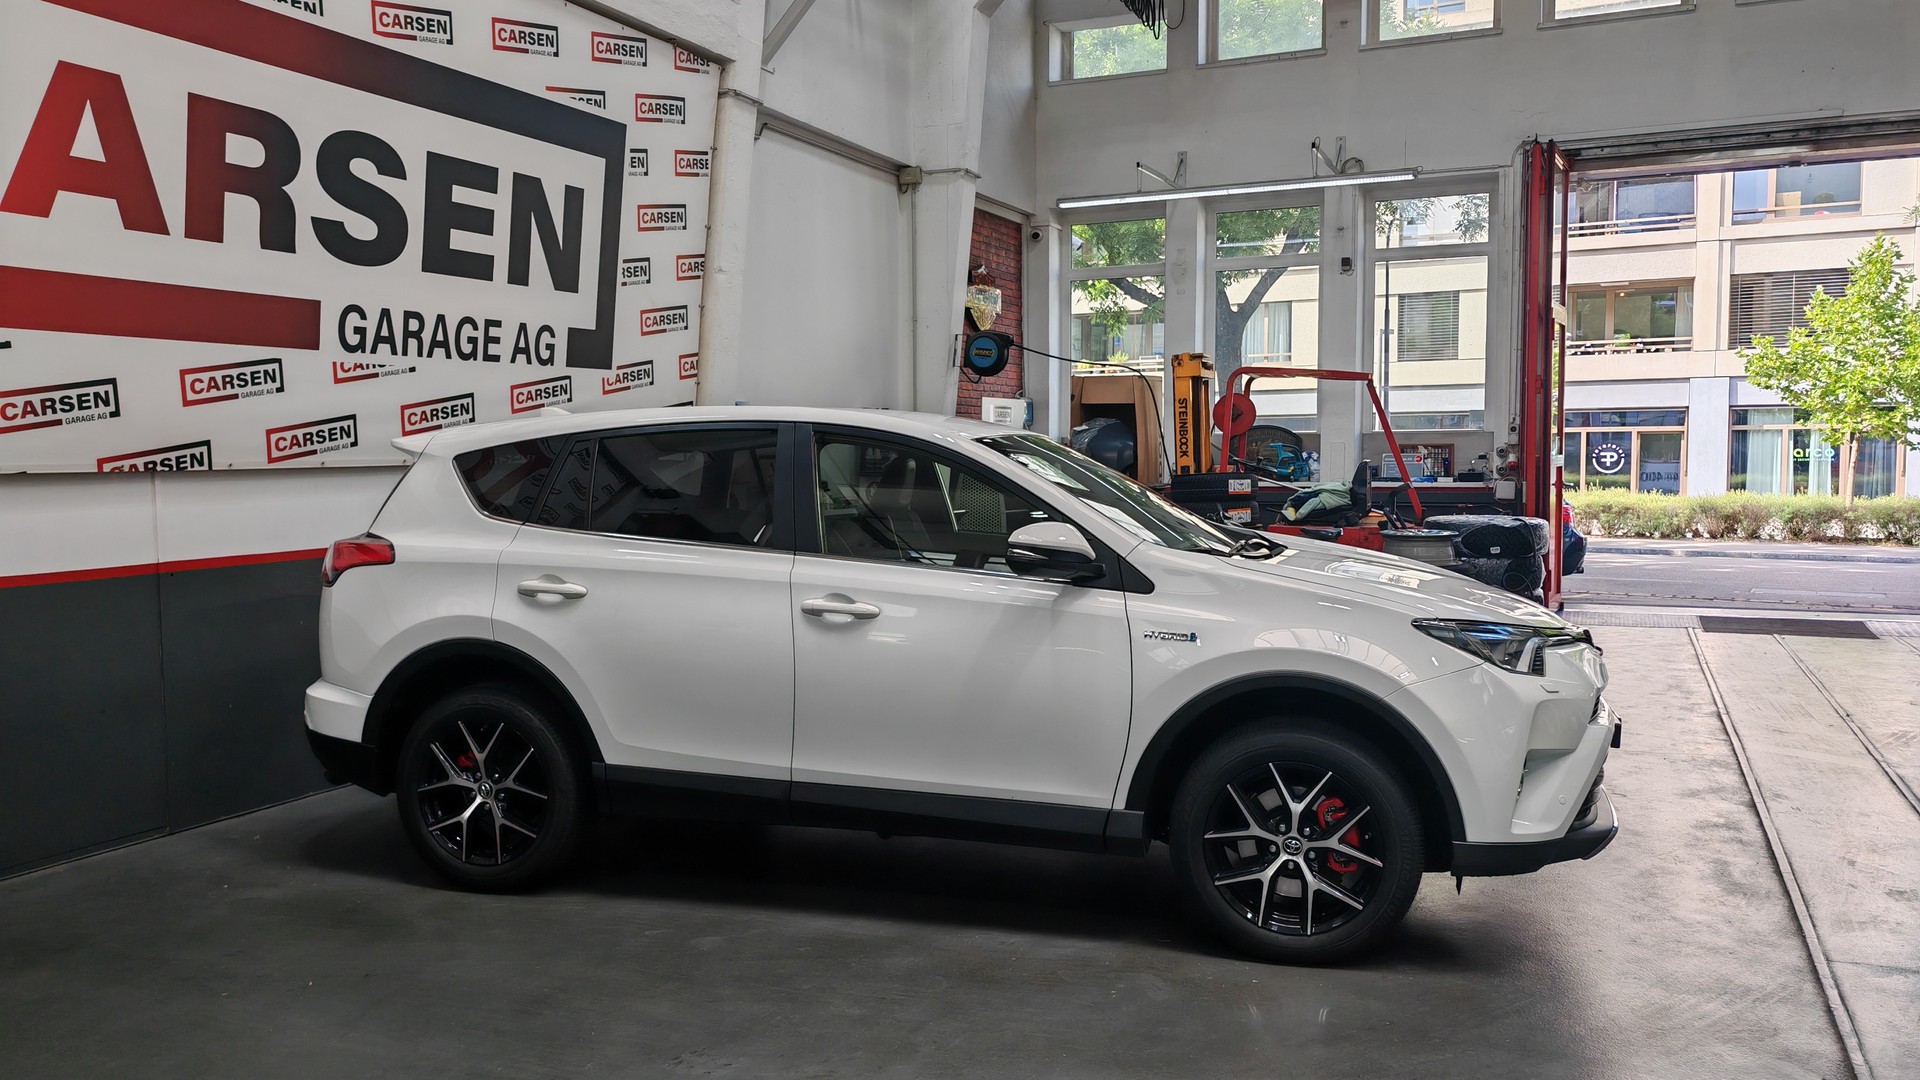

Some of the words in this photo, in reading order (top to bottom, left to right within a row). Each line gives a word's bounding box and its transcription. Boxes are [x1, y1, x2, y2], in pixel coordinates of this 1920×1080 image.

[378, 11, 448, 35] CARSEN
[418, 35, 438, 44] GARAGE
[438, 37, 446, 45] AG
[497, 27, 555, 48] CARSEN
[595, 40, 644, 59] CARSEN
[639, 101, 682, 117] CARSEN
[0, 60, 585, 294] ARSEN
[641, 211, 684, 224] CARSEN
[644, 312, 685, 328] CARSEN
[338, 304, 502, 363] GARAGE
[510, 321, 556, 366] AG
[189, 367, 277, 395] CARSEN
[380, 369, 400, 378] GARAGE
[400, 367, 408, 375] AG
[240, 389, 265, 399] GARAGE
[265, 387, 275, 396] AG
[515, 383, 569, 405] CARSEN
[0, 390, 111, 422] CARSEN
[407, 402, 470, 427] CARSEN
[65, 414, 96, 425] GARAGE
[97, 412, 108, 421] AG
[443, 420, 461, 429] GARAGE
[1178, 397, 1189, 459] STEINBOCK
[274, 424, 352, 452] CARSEN
[319, 443, 341, 454] GARAGE
[341, 442, 349, 450] AG
[1793, 448, 1835, 458] arco
